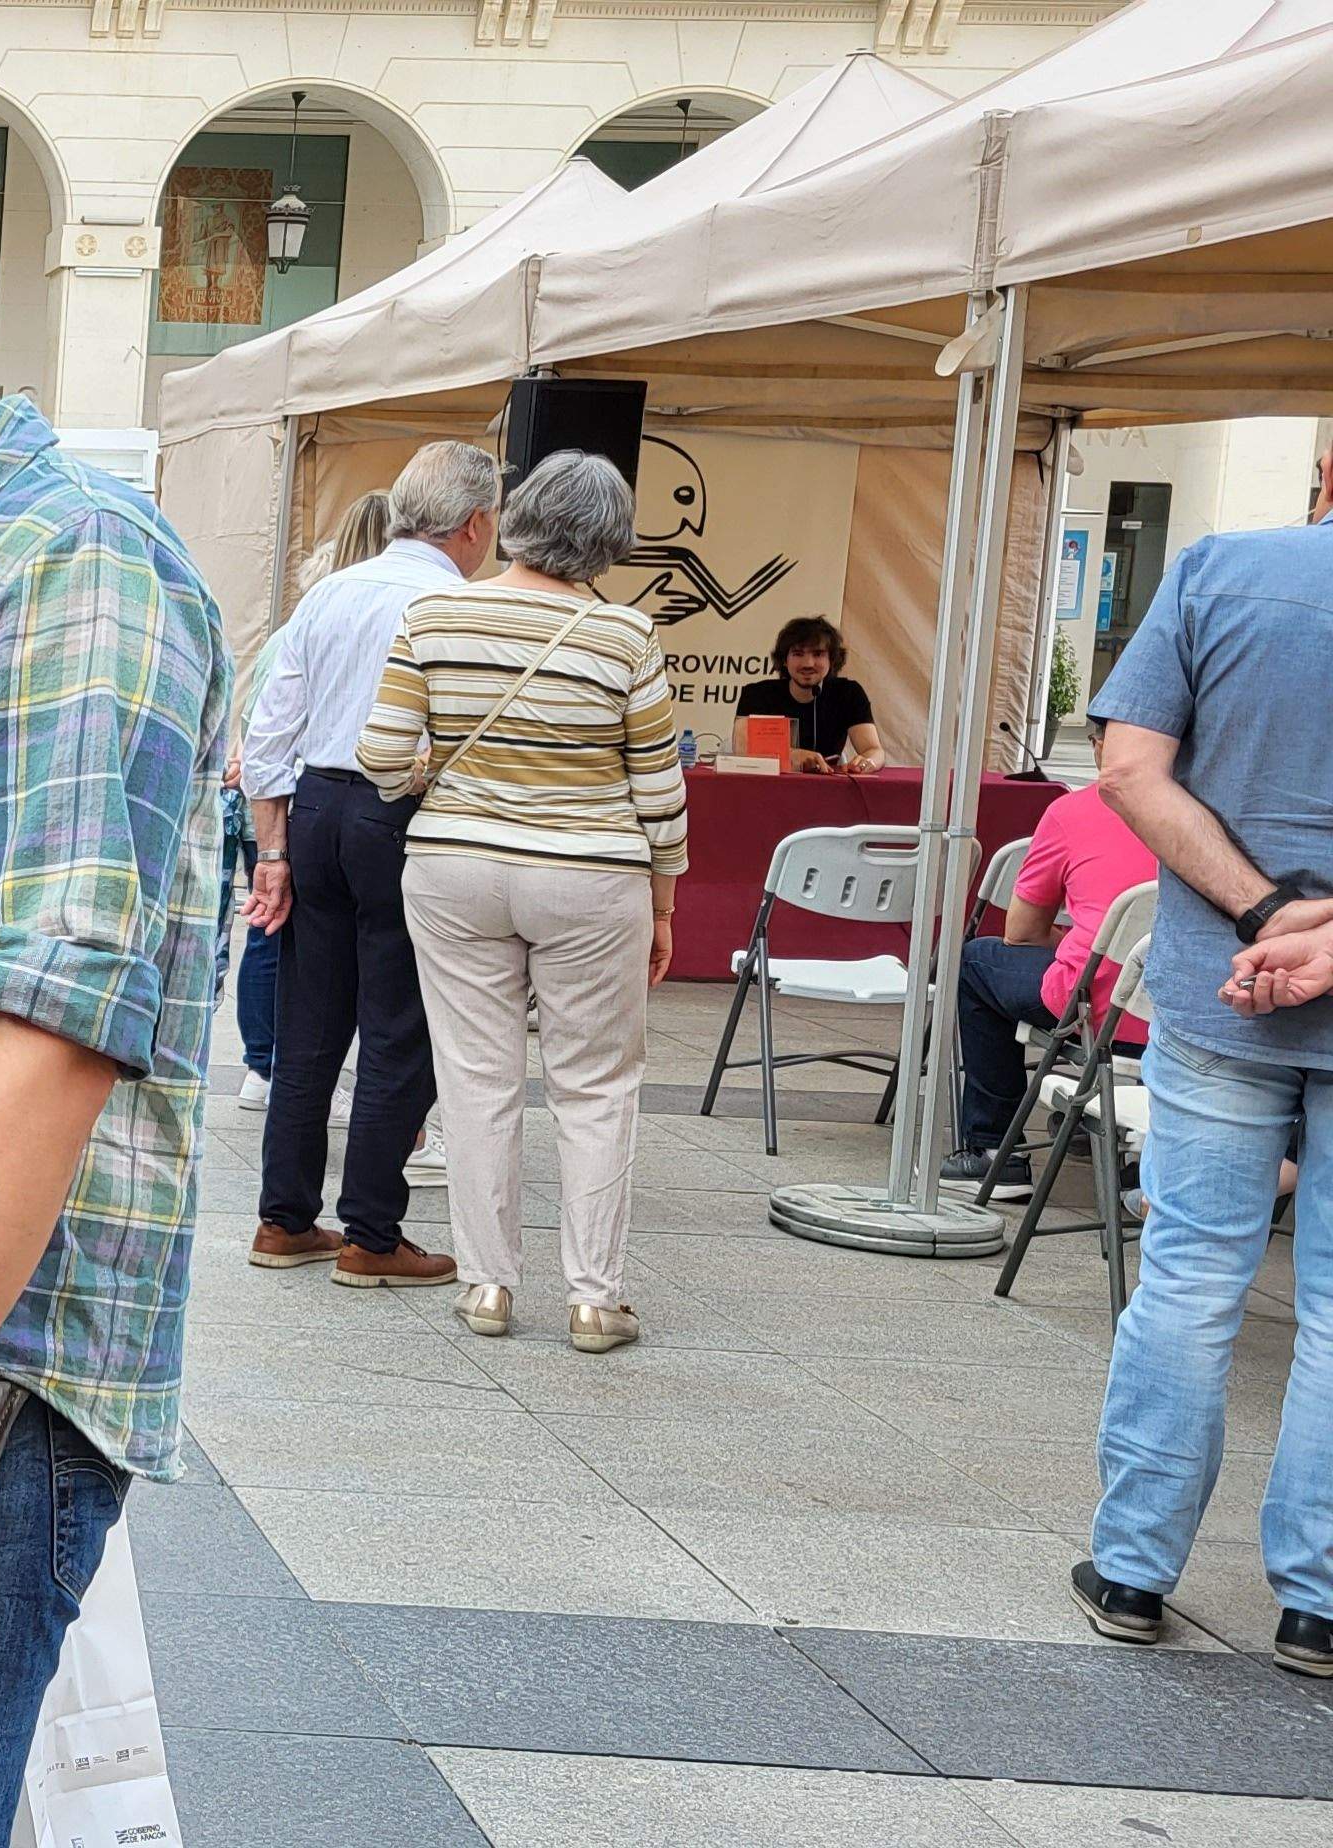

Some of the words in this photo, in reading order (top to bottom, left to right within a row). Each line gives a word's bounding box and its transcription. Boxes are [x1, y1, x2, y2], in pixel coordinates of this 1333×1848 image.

[664, 654, 779, 675] ROVINCI
[703, 685, 738, 704] HU
[129, 1835, 139, 1843] DE
